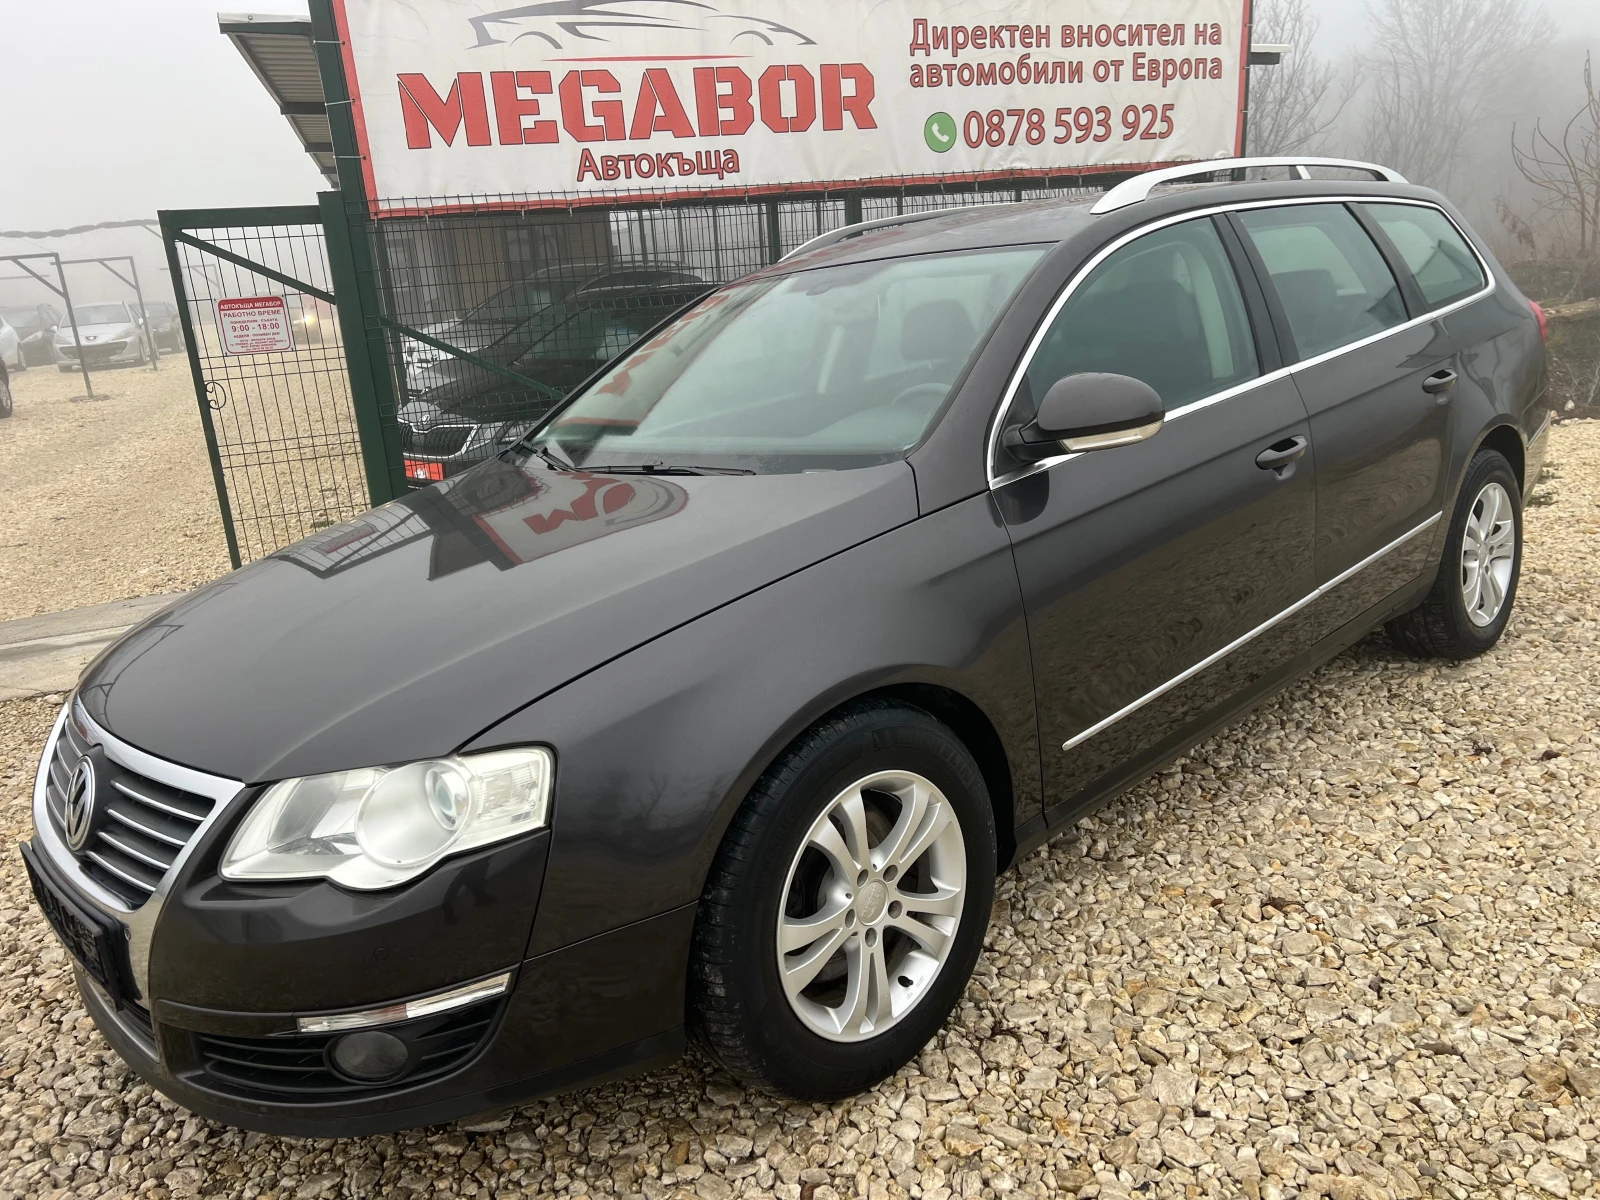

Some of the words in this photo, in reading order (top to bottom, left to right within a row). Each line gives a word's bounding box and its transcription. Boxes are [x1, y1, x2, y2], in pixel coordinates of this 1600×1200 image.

[909, 18, 1051, 57] Директен
[1060, 22, 1186, 48] вносител
[1194, 22, 1223, 46] на
[909, 53, 1084, 88] автомобили
[1093, 59, 1124, 83] от
[1132, 51, 1223, 87] Европа
[396, 62, 878, 149] MEGABOR
[963, 107, 1046, 149] 0878
[1053, 105, 1112, 145] 593
[1121, 103, 1175, 141] 925
[577, 147, 740, 182] Автокъща
[254, 300, 281, 308] МЕГАБОР
[231, 324, 250, 332] 9:00
[257, 322, 280, 331] 18:00
